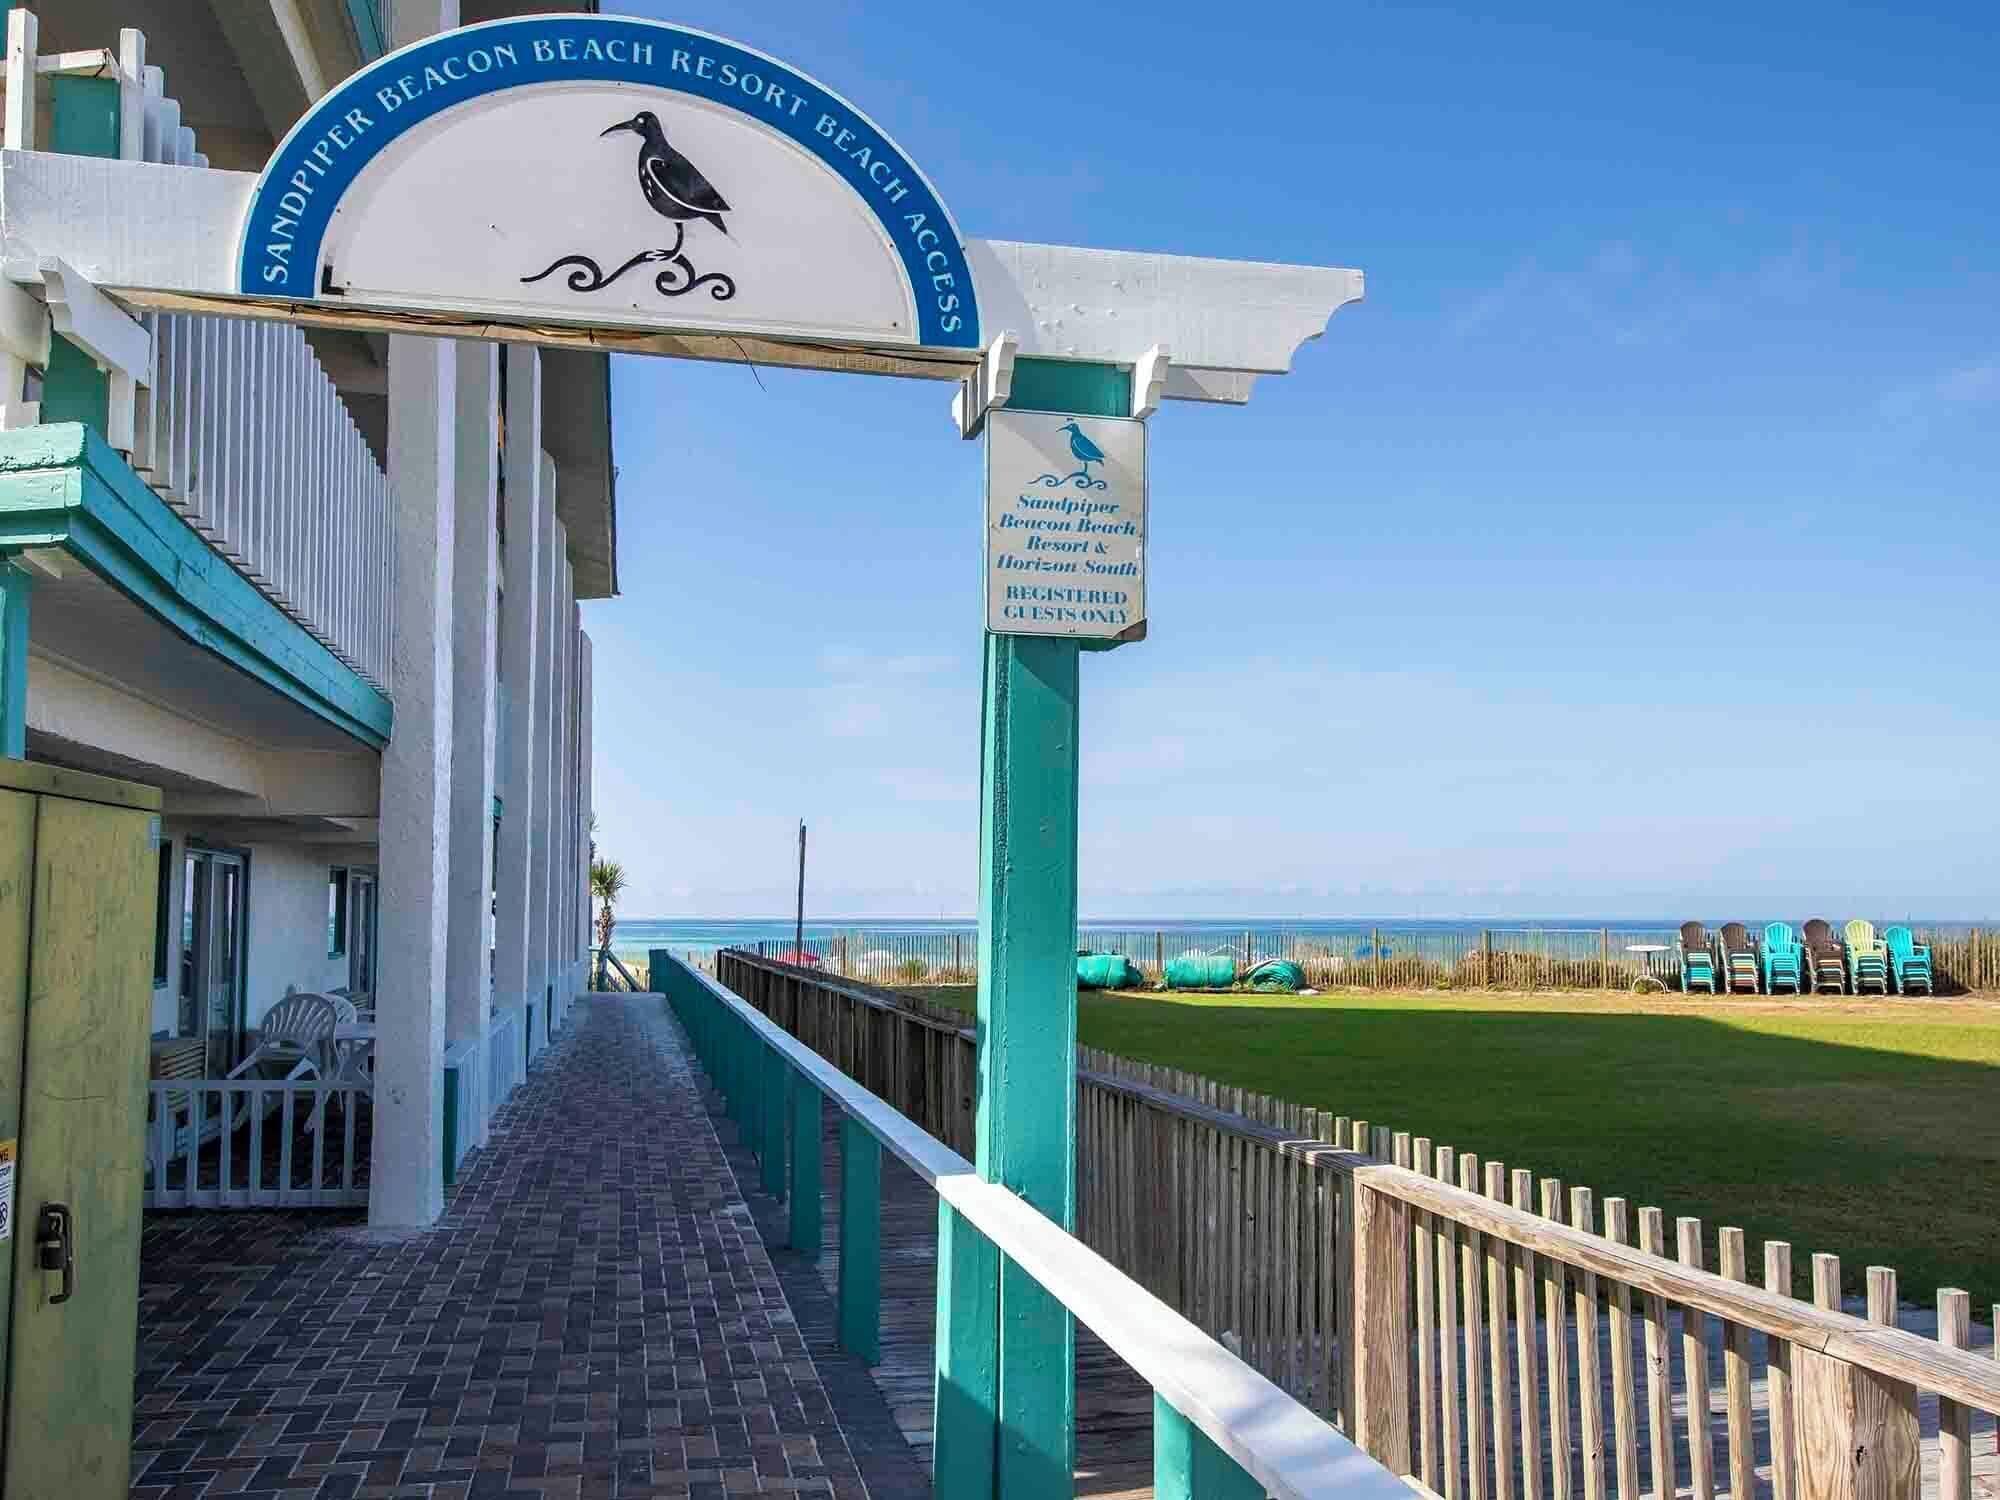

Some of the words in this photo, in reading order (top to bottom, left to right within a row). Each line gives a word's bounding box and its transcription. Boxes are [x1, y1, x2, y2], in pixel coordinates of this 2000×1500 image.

[264, 108, 375, 284] SANDPIPER
[376, 43, 519, 113] BEACON
[533, 38, 653, 63] BEACH
[670, 49, 808, 117] RESORT
[814, 112, 910, 204] BEACH
[903, 212, 962, 334] ACCESS
[1016, 495, 1120, 517] Sandpiper
[999, 514, 1072, 532] Beacon
[1076, 519, 1137, 536] Beach
[1026, 536, 1089, 554] Resort
[1093, 541, 1110, 555] &
[996, 555, 1077, 573] Horizon
[1082, 559, 1138, 577] South
[1006, 585, 1128, 605] REGISTERED
[1003, 605, 1078, 622] GUESTS
[1081, 607, 1129, 624] ONLY
